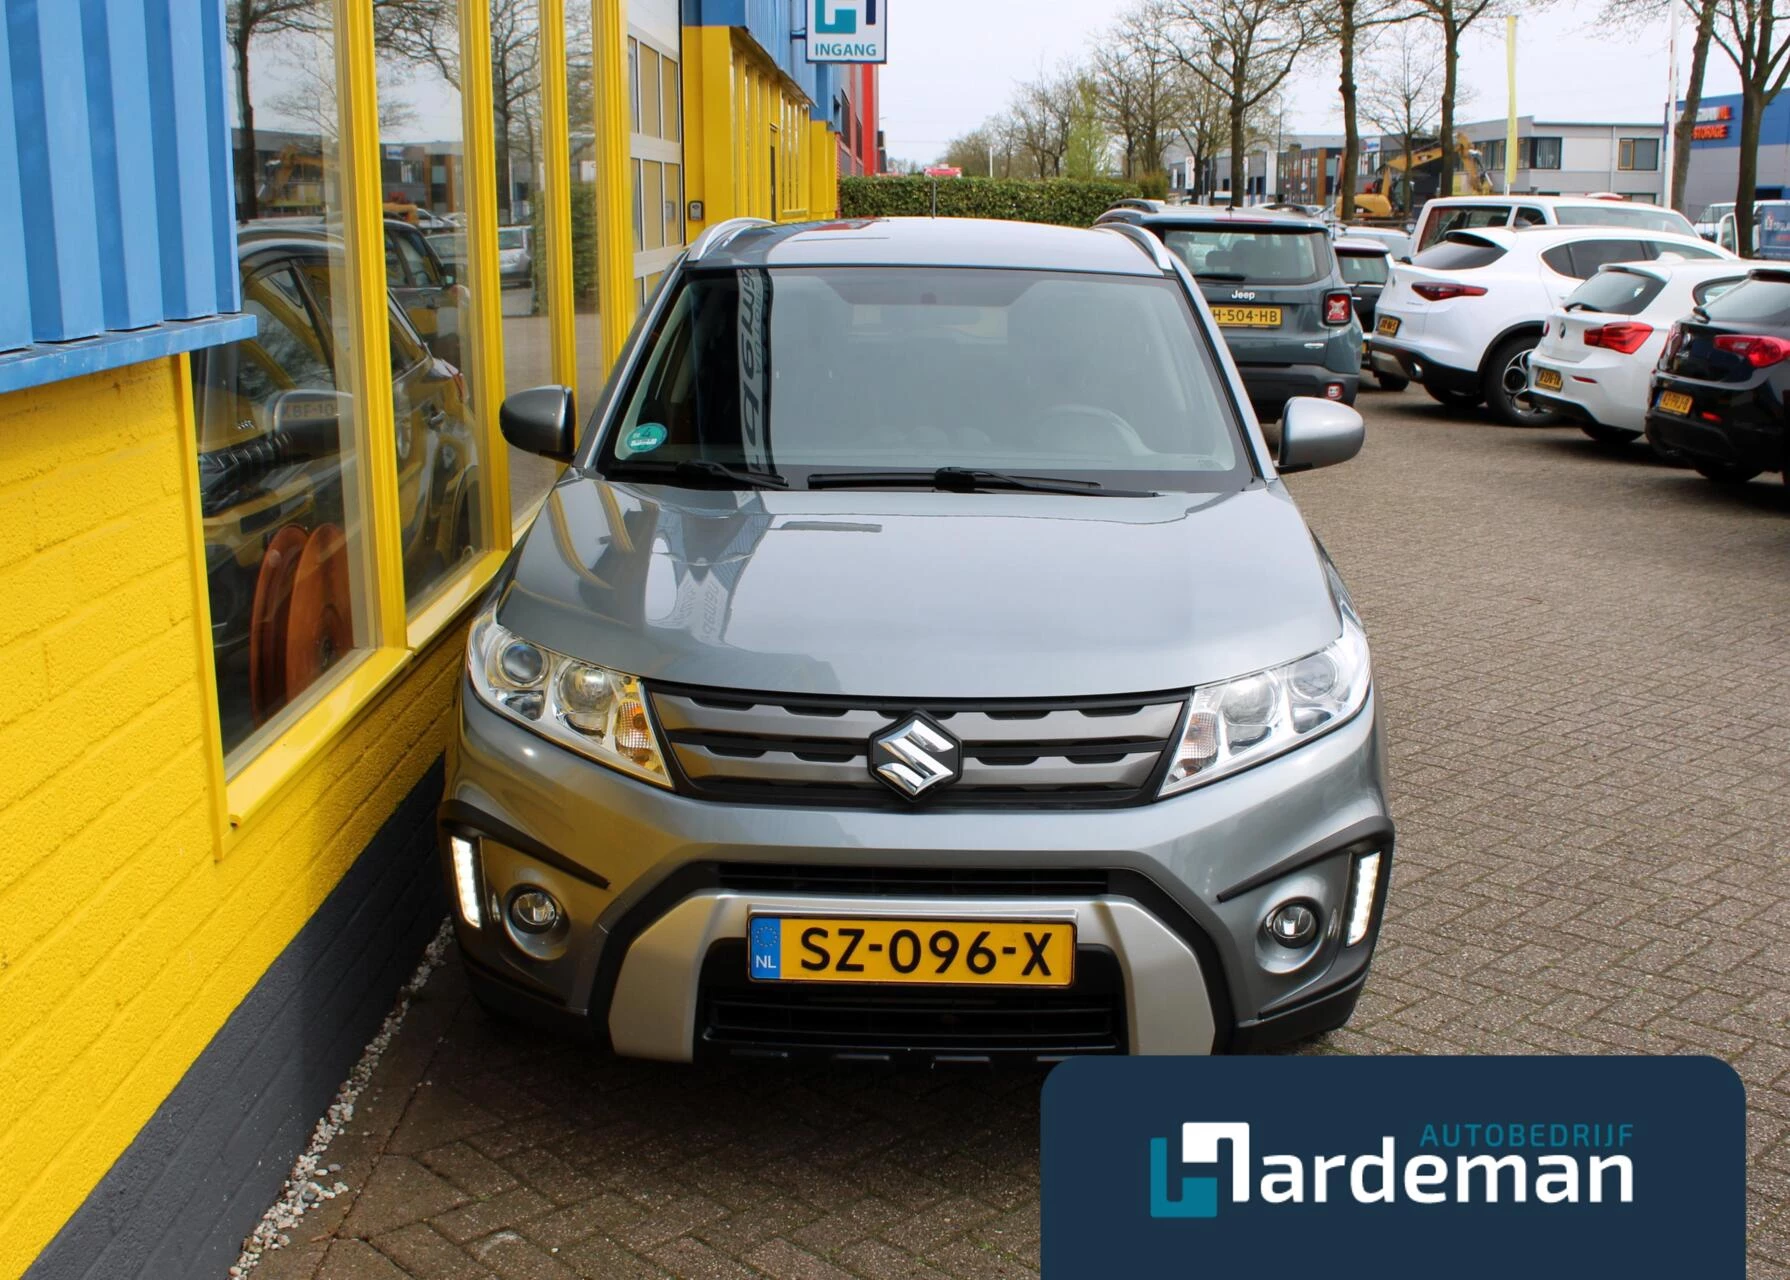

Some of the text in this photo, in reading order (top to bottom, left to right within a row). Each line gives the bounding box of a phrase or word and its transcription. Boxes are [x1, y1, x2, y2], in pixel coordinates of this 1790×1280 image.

[815, 43, 877, 57] INGANG
[1231, 290, 1256, 301] Jeep
[800, 927, 1053, 977] SZ-096-X
[755, 955, 777, 969] NL
